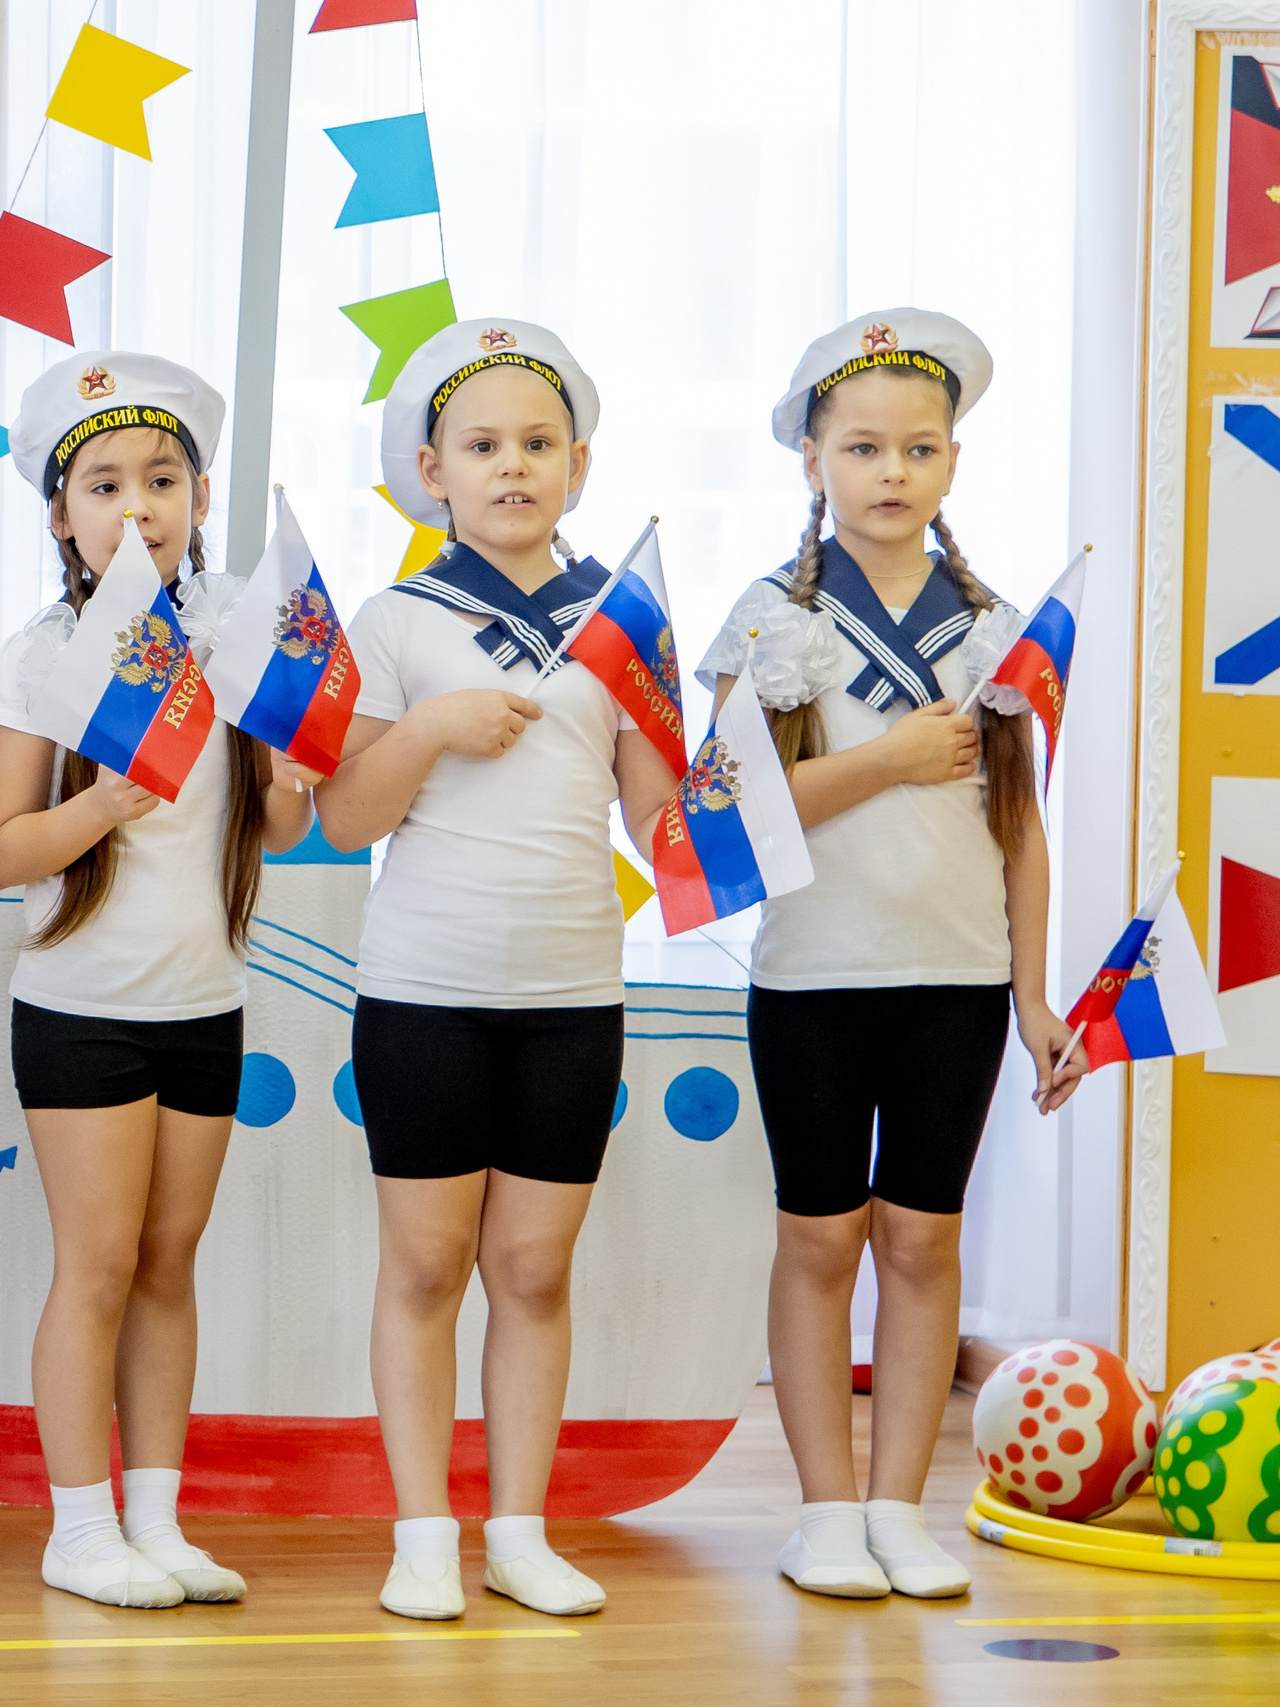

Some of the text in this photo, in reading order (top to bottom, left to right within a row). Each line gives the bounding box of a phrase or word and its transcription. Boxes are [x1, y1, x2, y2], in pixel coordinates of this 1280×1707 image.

[432, 353, 562, 412] РОССИЙСКИЙ ФЛОТ
[912, 355, 946, 381] ФЛОТ
[55, 405, 178, 467] РОССИЙСКИЙ ФЛОТ
[625, 658, 682, 740] РОССИЯ
